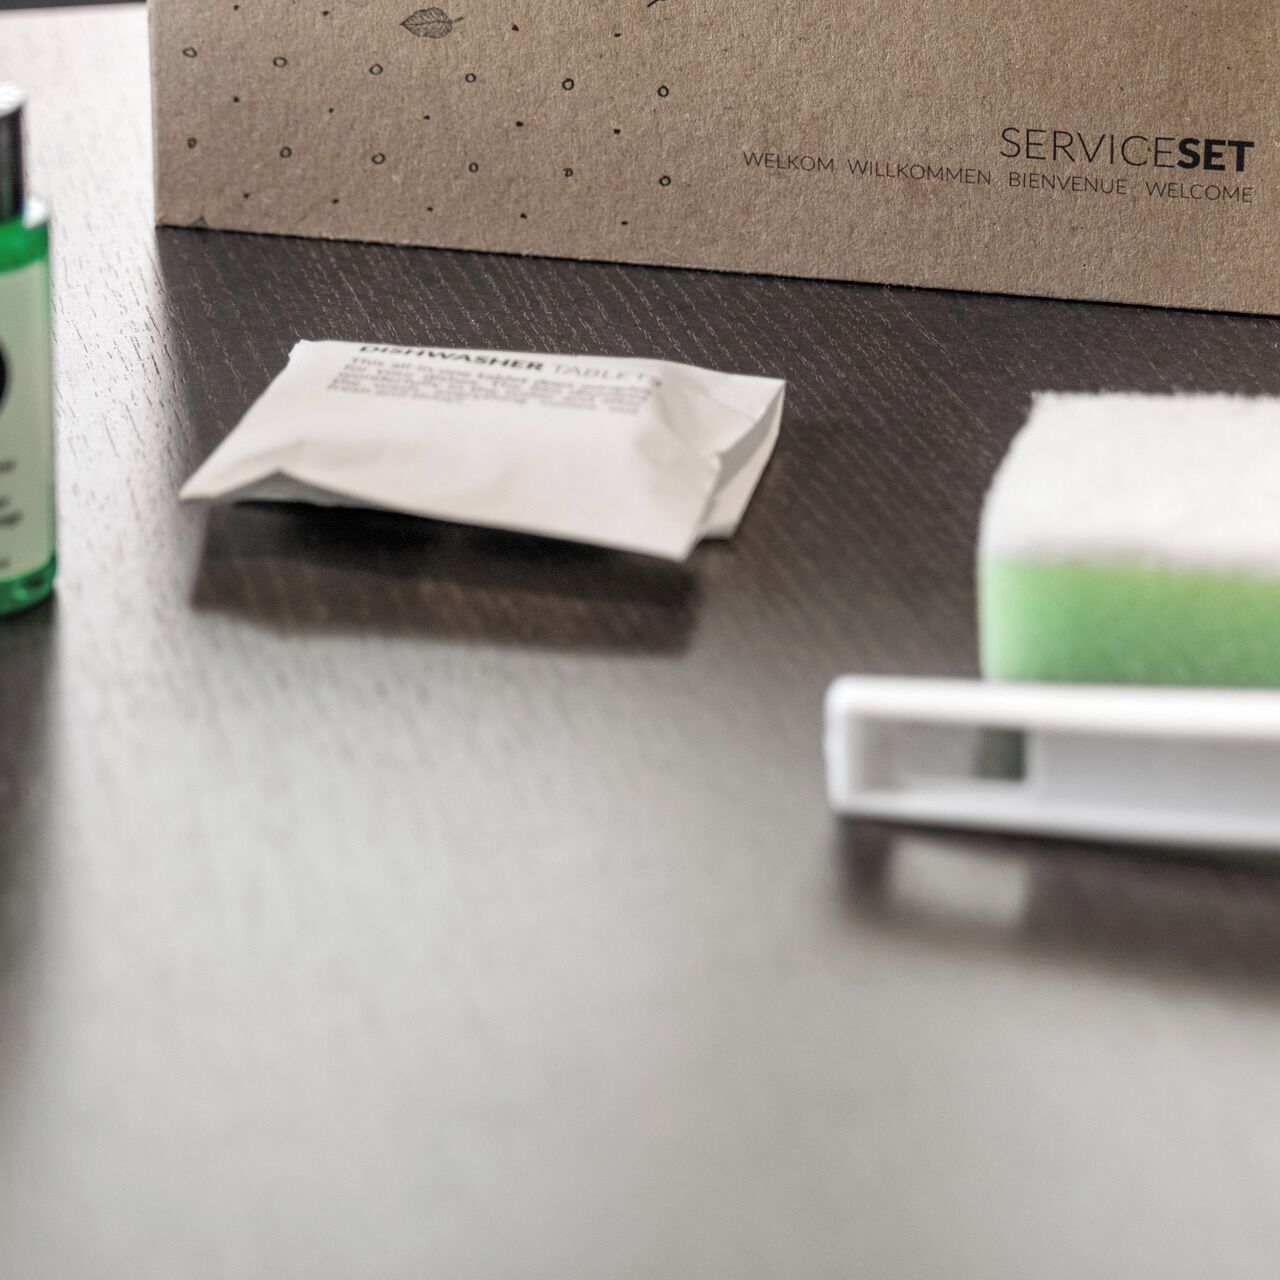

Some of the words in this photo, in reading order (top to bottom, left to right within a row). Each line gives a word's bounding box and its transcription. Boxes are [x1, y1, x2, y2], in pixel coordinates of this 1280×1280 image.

[1000, 127, 1255, 172] SERVICESET
[743, 151, 834, 173] WELKOM
[847, 159, 991, 185] WILLKOMMEN
[1009, 172, 1128, 195] BIENVENUE
[1146, 181, 1253, 204] WELCOME
[359, 345, 544, 371] DISHWASHER
